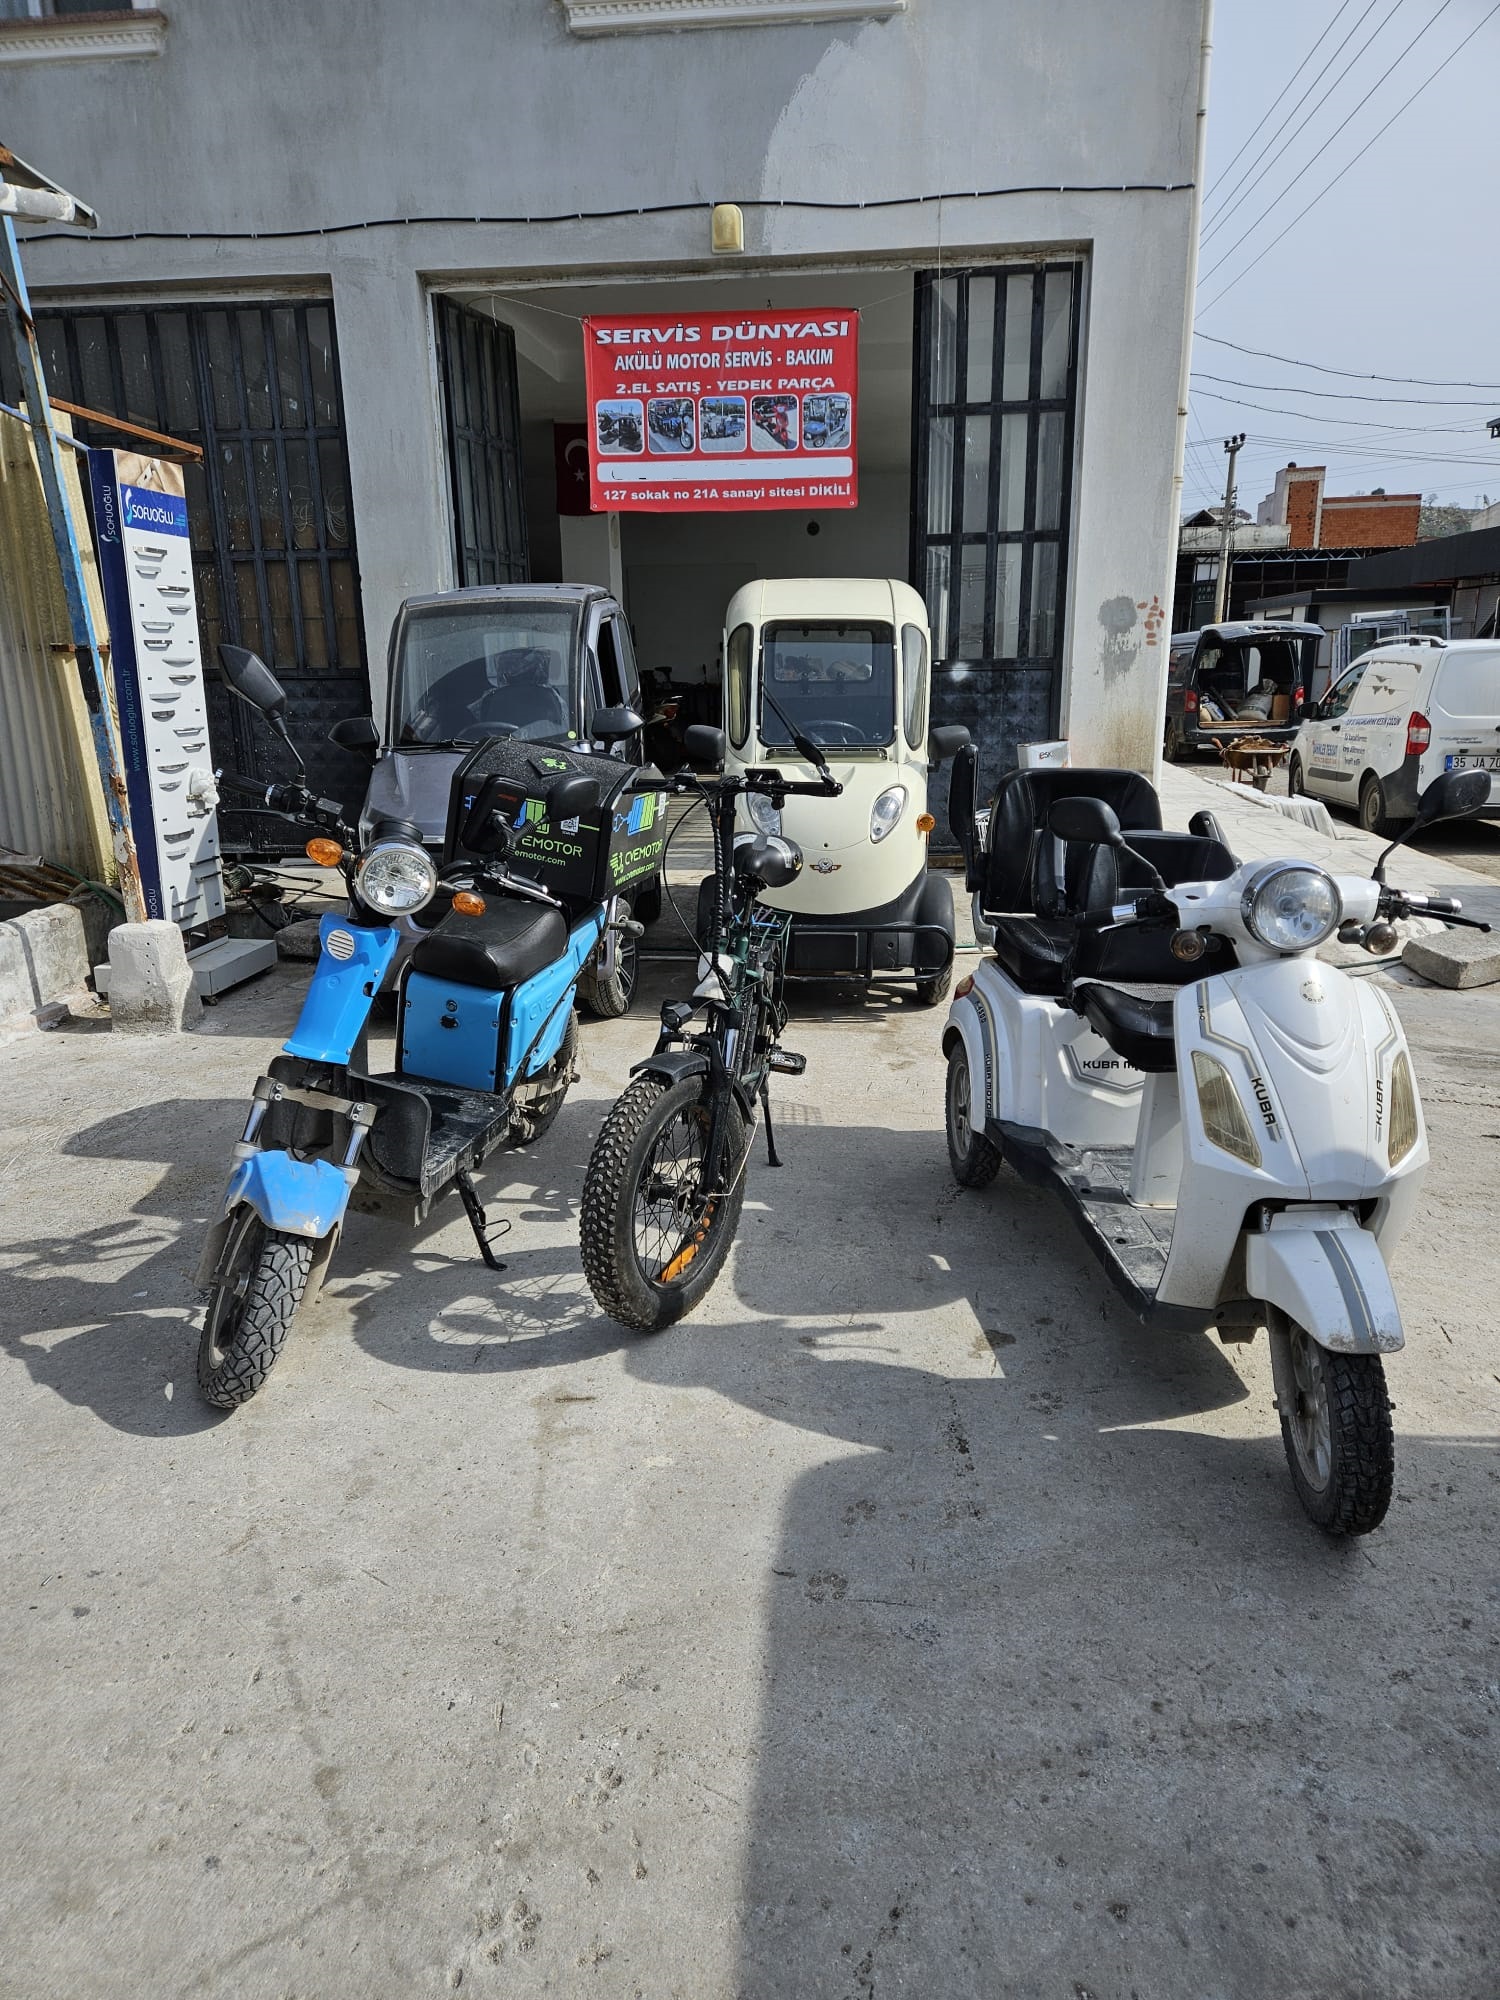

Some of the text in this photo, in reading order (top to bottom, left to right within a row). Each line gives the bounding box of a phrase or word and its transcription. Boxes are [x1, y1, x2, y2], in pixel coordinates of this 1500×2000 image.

[596, 321, 849, 344] SERVİS DÜNYASI
[614, 350, 662, 371] AKÜLÜ
[666, 352, 720, 370] MOTOR
[725, 346, 772, 368] SERVİS
[786, 348, 833, 366] BAKIM
[616, 382, 651, 394] 2.EL
[656, 381, 701, 395] SATIŞ
[717, 379, 772, 391] YEDEK
[778, 377, 835, 391] PARÇA
[603, 482, 851, 500] 127 sokak no 21A sanayi sitesi DİKİLİ
[122, 669, 140, 772] www.sofuoglu.com.tr
[1453, 757, 1466, 768] 35
[1472, 757, 1485, 768] JA
[522, 835, 582, 857] EMOTOR
[514, 850, 566, 866] emotor.com
[1083, 1060, 1119, 1069] KUBA
[1251, 1077, 1277, 1125] KUBA
[1375, 1079, 1383, 1126] KUBA
